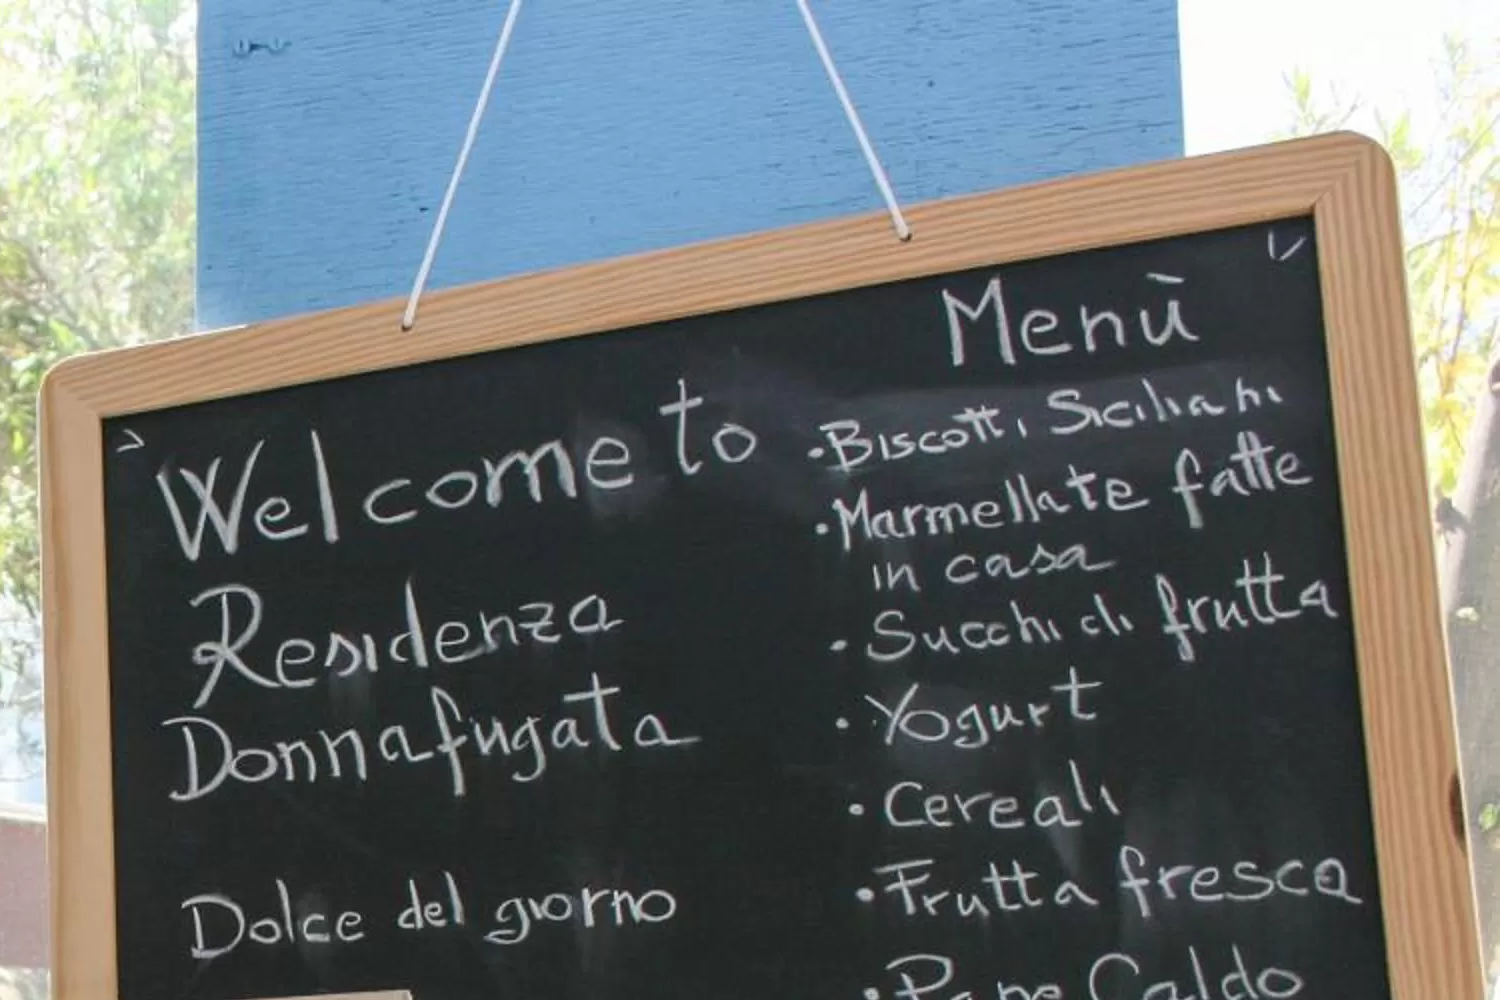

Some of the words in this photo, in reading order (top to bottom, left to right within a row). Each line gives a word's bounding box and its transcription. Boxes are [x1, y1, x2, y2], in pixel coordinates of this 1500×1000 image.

[941, 273, 1199, 367] Menù
[156, 430, 633, 561] Welcome
[660, 378, 757, 475] to
[820, 406, 1027, 471] Biscotti
[1047, 377, 1283, 434] Siciliani
[833, 464, 1149, 552] Marmellate
[1172, 431, 1313, 529] fatte
[866, 600, 1061, 662] Succhi
[1082, 594, 1132, 638] di
[1155, 552, 1337, 661] frutta
[873, 563, 921, 592] in
[946, 543, 1115, 585] casa
[190, 576, 625, 709] Residenza
[160, 672, 700, 800] Donnafugata
[865, 666, 1100, 749] Yogurt
[884, 759, 1120, 829] Cereali
[181, 879, 365, 959] Dolce
[398, 871, 465, 932] del
[483, 887, 676, 945] giorno
[874, 859, 1098, 918] Frutta
[1119, 845, 1361, 917] fresca
